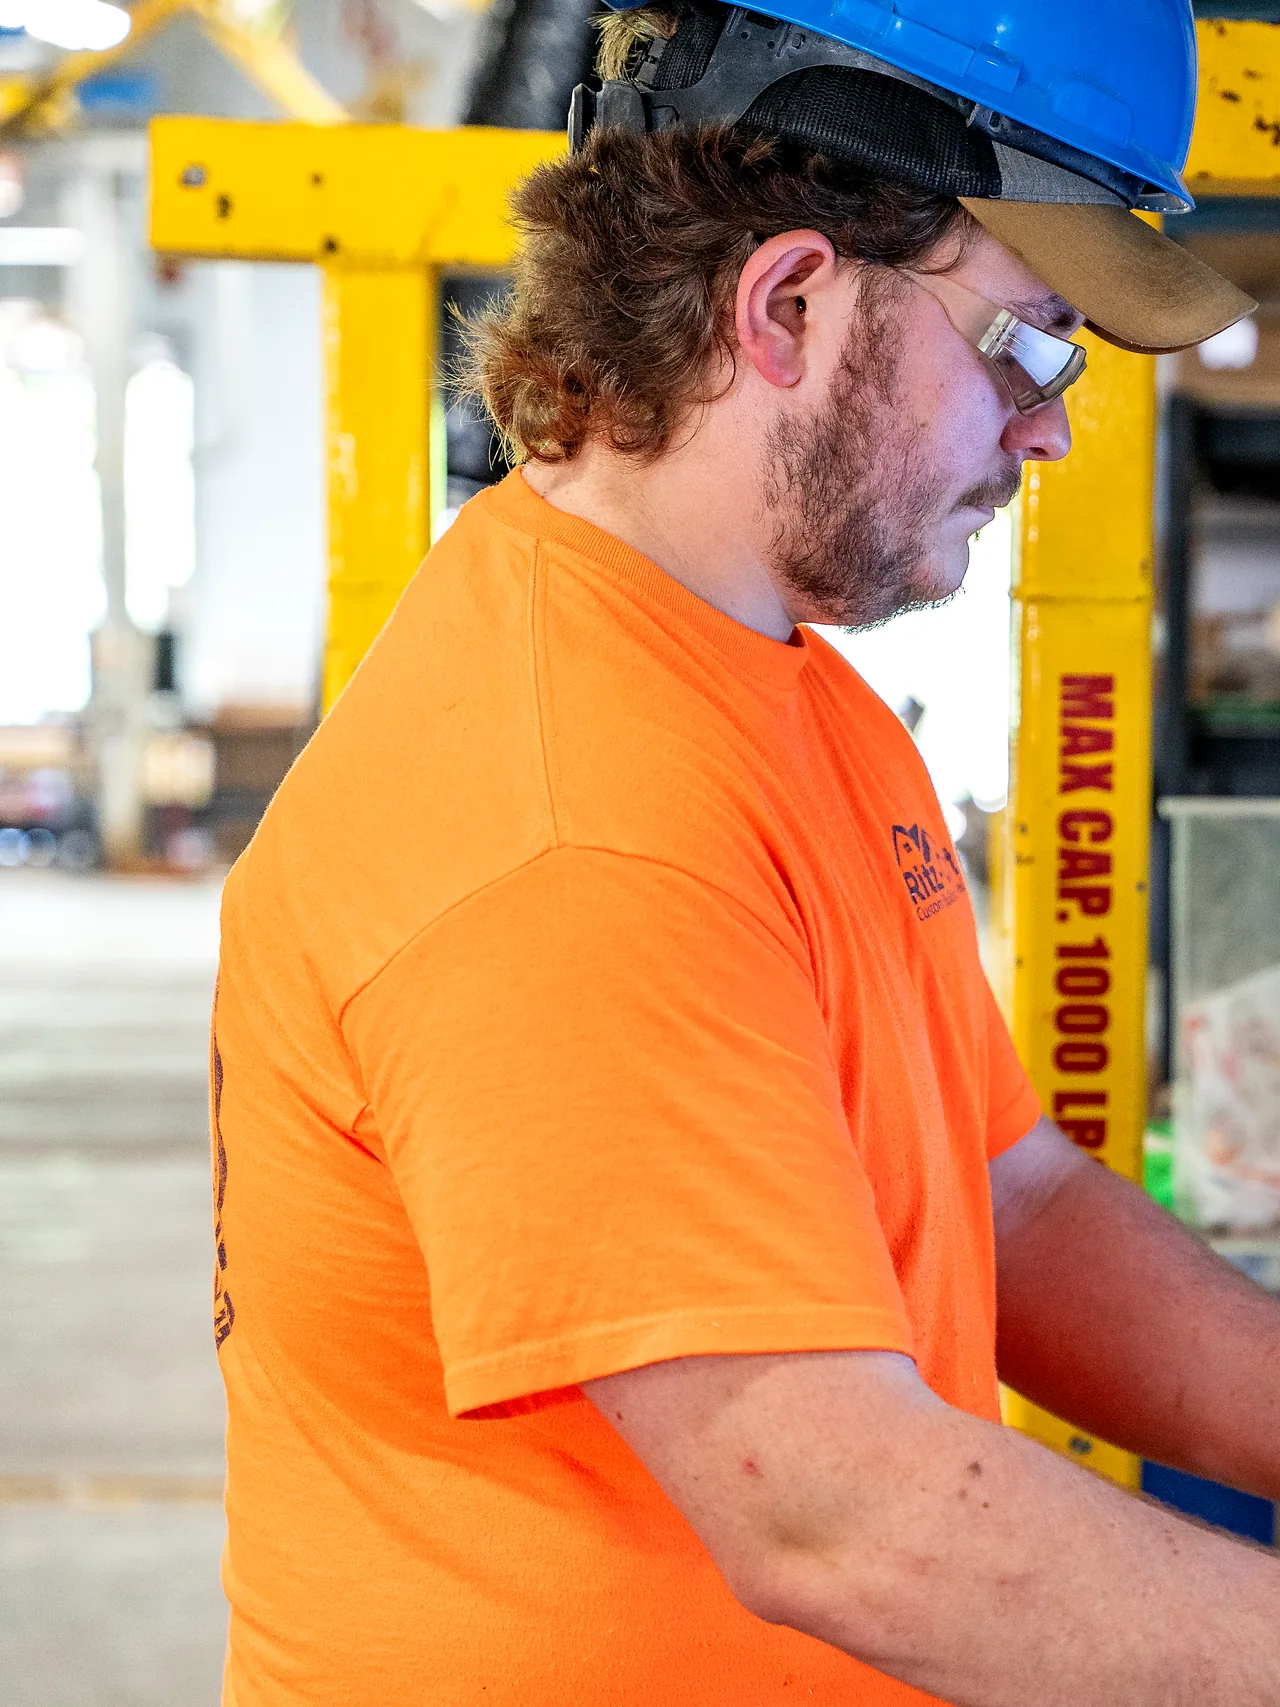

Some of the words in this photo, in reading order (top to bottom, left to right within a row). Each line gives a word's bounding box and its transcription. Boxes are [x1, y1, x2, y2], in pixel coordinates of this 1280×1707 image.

[1059, 674, 1114, 794] MAX
[1055, 808, 1114, 922] CAP.
[1055, 934, 1112, 1072] 1000
[1052, 1092, 1108, 1164] LB
